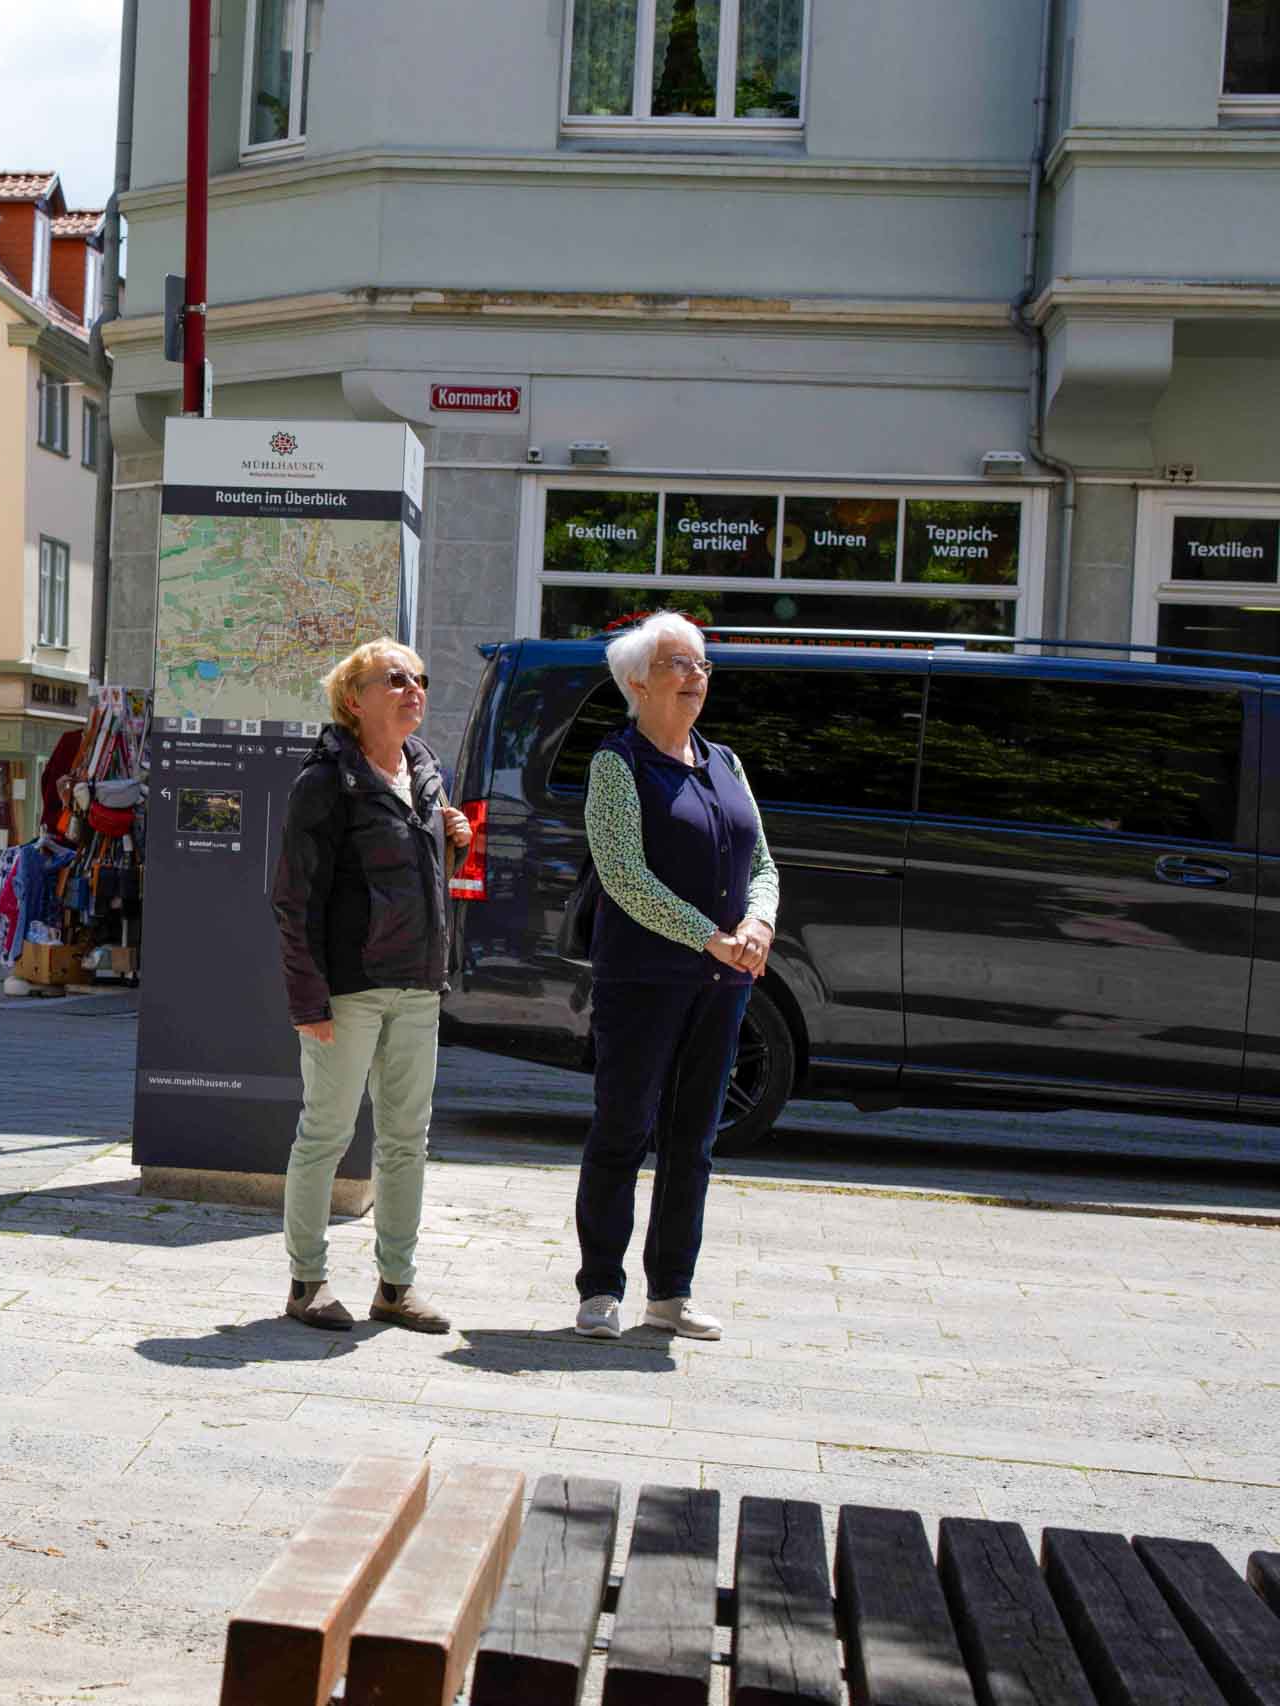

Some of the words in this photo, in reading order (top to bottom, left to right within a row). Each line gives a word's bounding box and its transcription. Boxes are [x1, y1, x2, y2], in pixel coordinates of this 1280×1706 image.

[438, 387, 512, 408] Kornmarkt
[241, 459, 325, 472] MÜHLHAUSEN
[215, 490, 262, 504] Routen
[265, 491, 282, 505] im
[284, 490, 348, 507] Überblick
[566, 523, 638, 541] Textilien
[677, 517, 766, 536] Geschenk-
[926, 524, 999, 543] Teppich-
[692, 535, 747, 552] artikel
[814, 530, 867, 548] Uhren
[933, 543, 989, 560] waren
[1188, 540, 1265, 559] Textilien
[148, 1076, 242, 1088] www.muehlhausen.de
